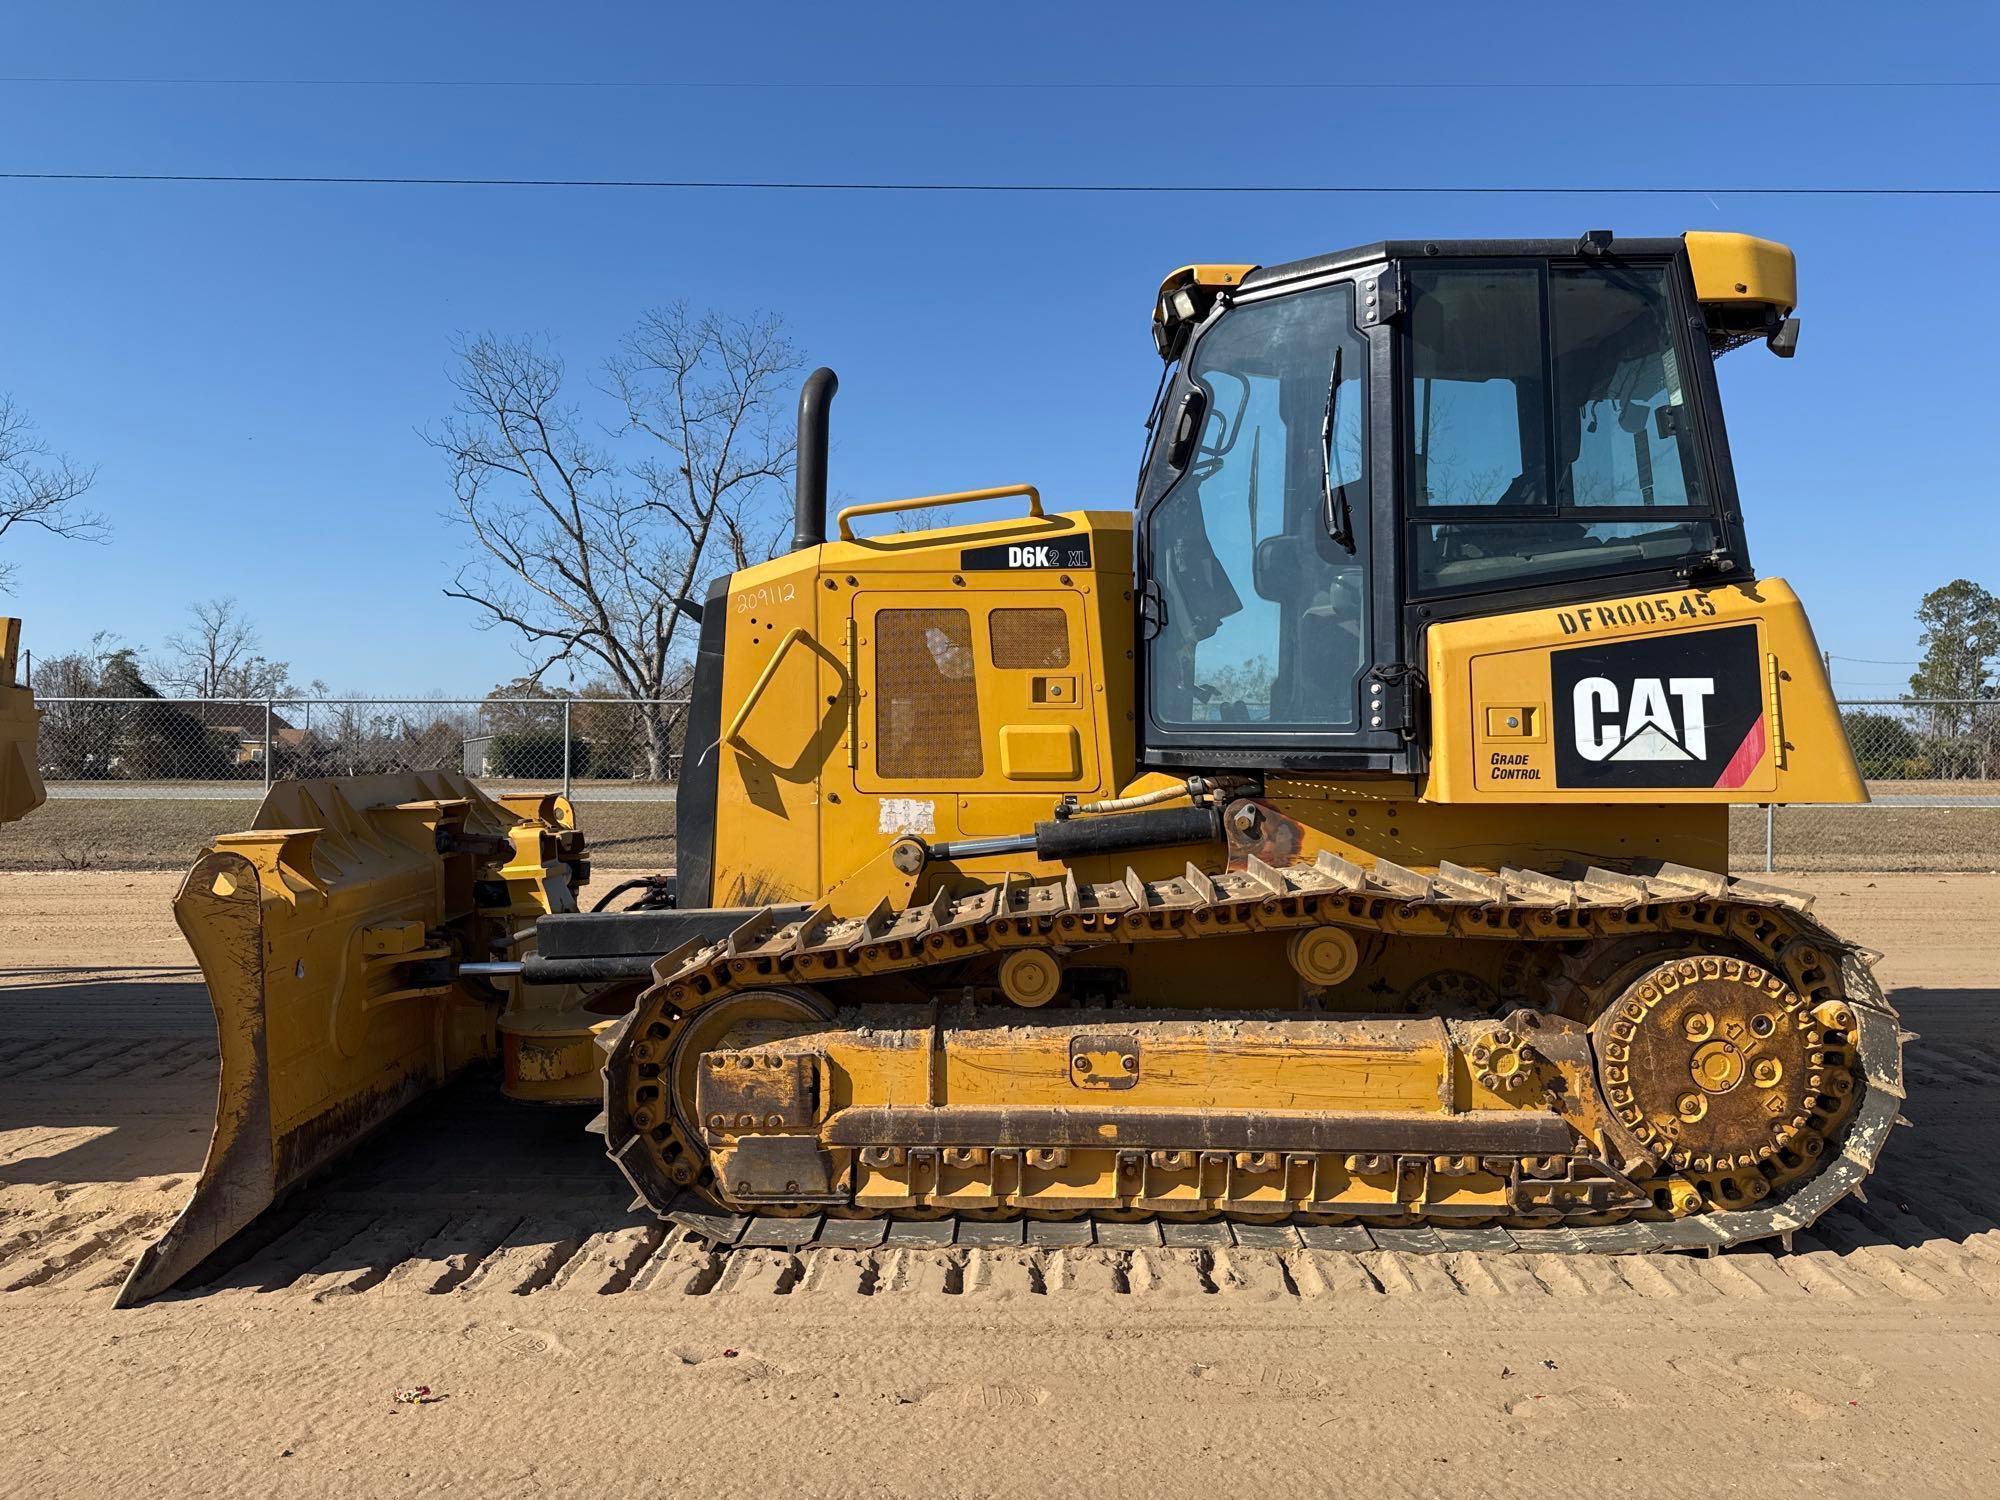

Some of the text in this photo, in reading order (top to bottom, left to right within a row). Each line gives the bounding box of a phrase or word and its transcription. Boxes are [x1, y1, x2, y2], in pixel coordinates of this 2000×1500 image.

[1067, 550, 1088, 567] XL
[737, 583, 795, 613] 209112
[1557, 593, 1716, 635] DFR00545
[1572, 676, 1715, 761] CAT
[1491, 752, 1529, 765] GRADE
[1491, 767, 1541, 780] CONTROL
